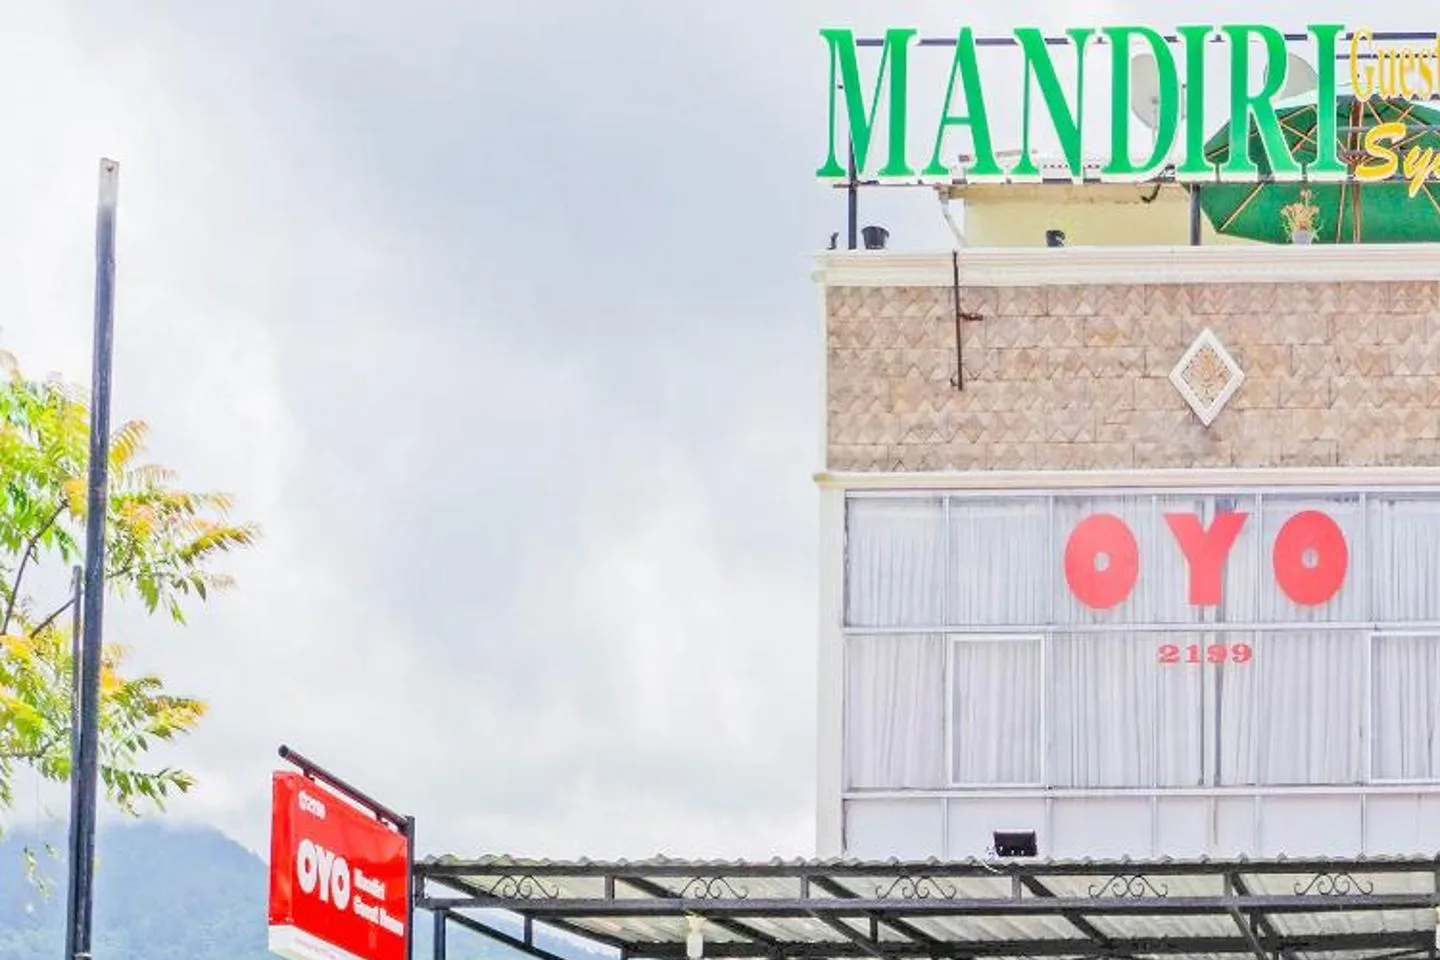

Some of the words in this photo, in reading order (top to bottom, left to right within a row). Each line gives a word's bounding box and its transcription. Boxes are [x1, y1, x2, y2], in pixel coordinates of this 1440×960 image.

[816, 24, 1346, 182] MANDIRI
[1063, 509, 1349, 610] OYO
[1158, 643, 1252, 664] 2199
[296, 838, 351, 911] OYO
